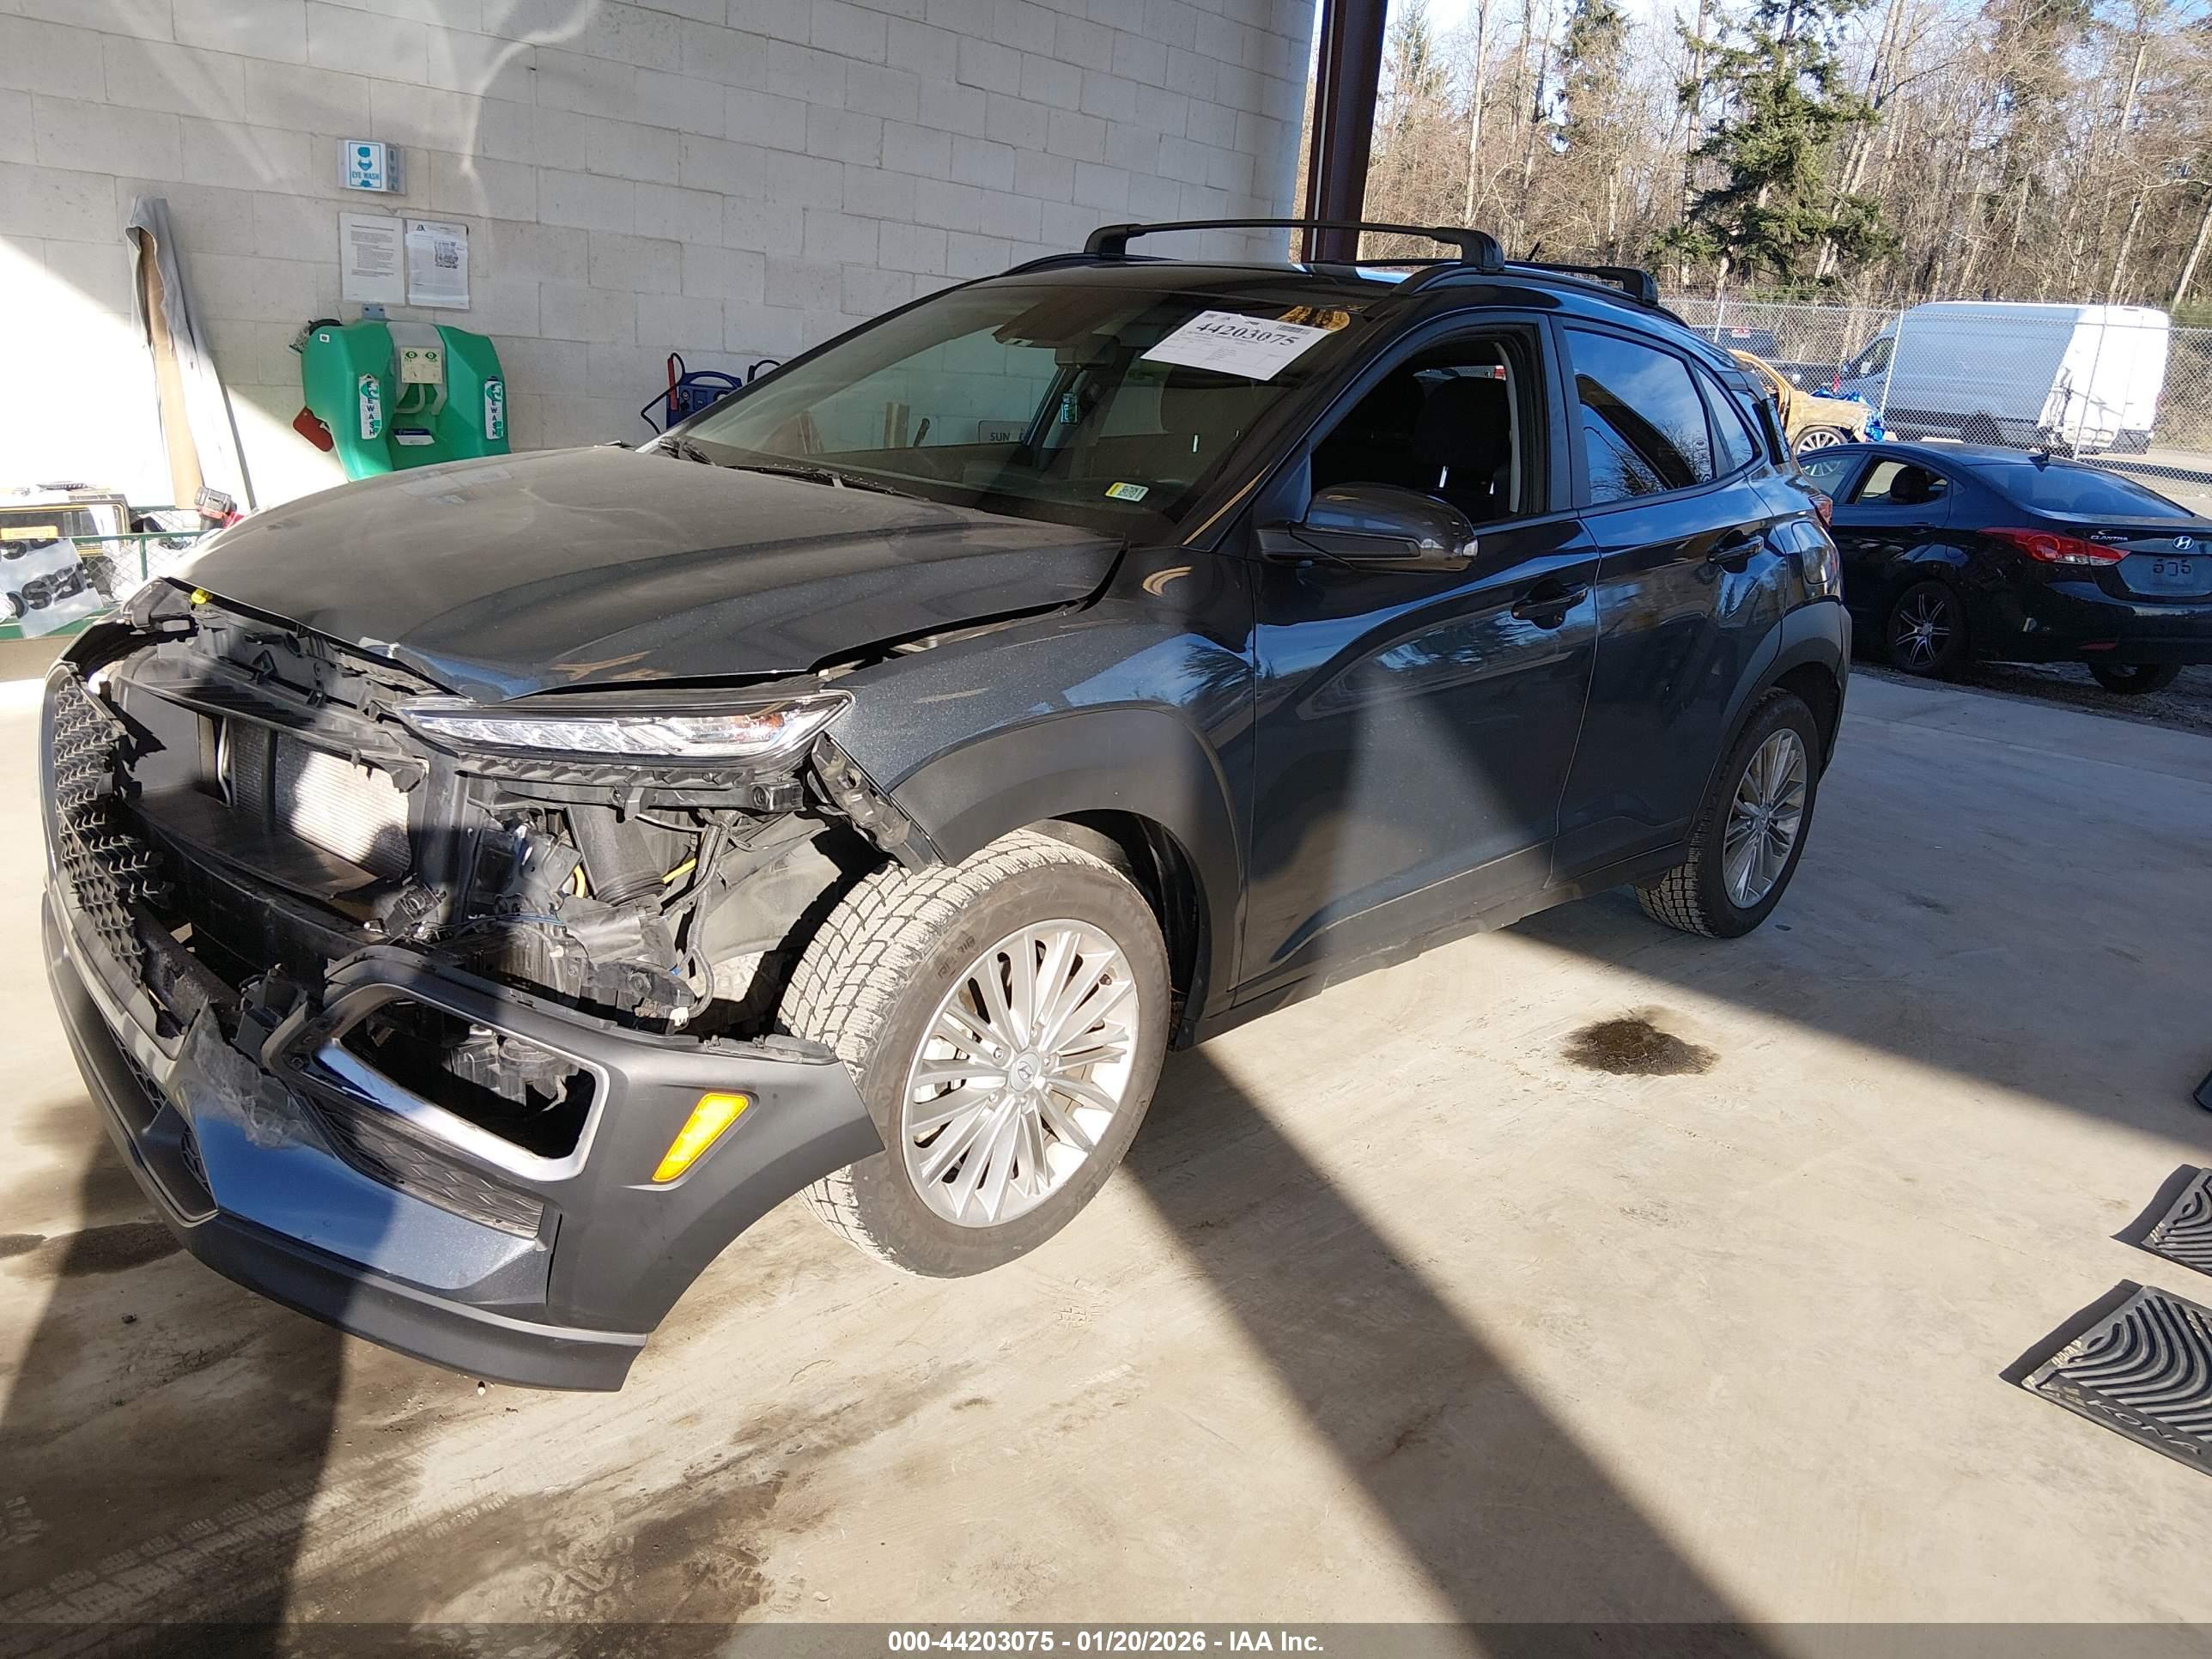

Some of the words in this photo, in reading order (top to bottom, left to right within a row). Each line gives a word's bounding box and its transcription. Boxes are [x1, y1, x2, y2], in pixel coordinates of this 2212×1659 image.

[1196, 322, 1301, 346] 44203075
[990, 432, 1011, 441] SUN
[2086, 1400, 2203, 1455] KONA
